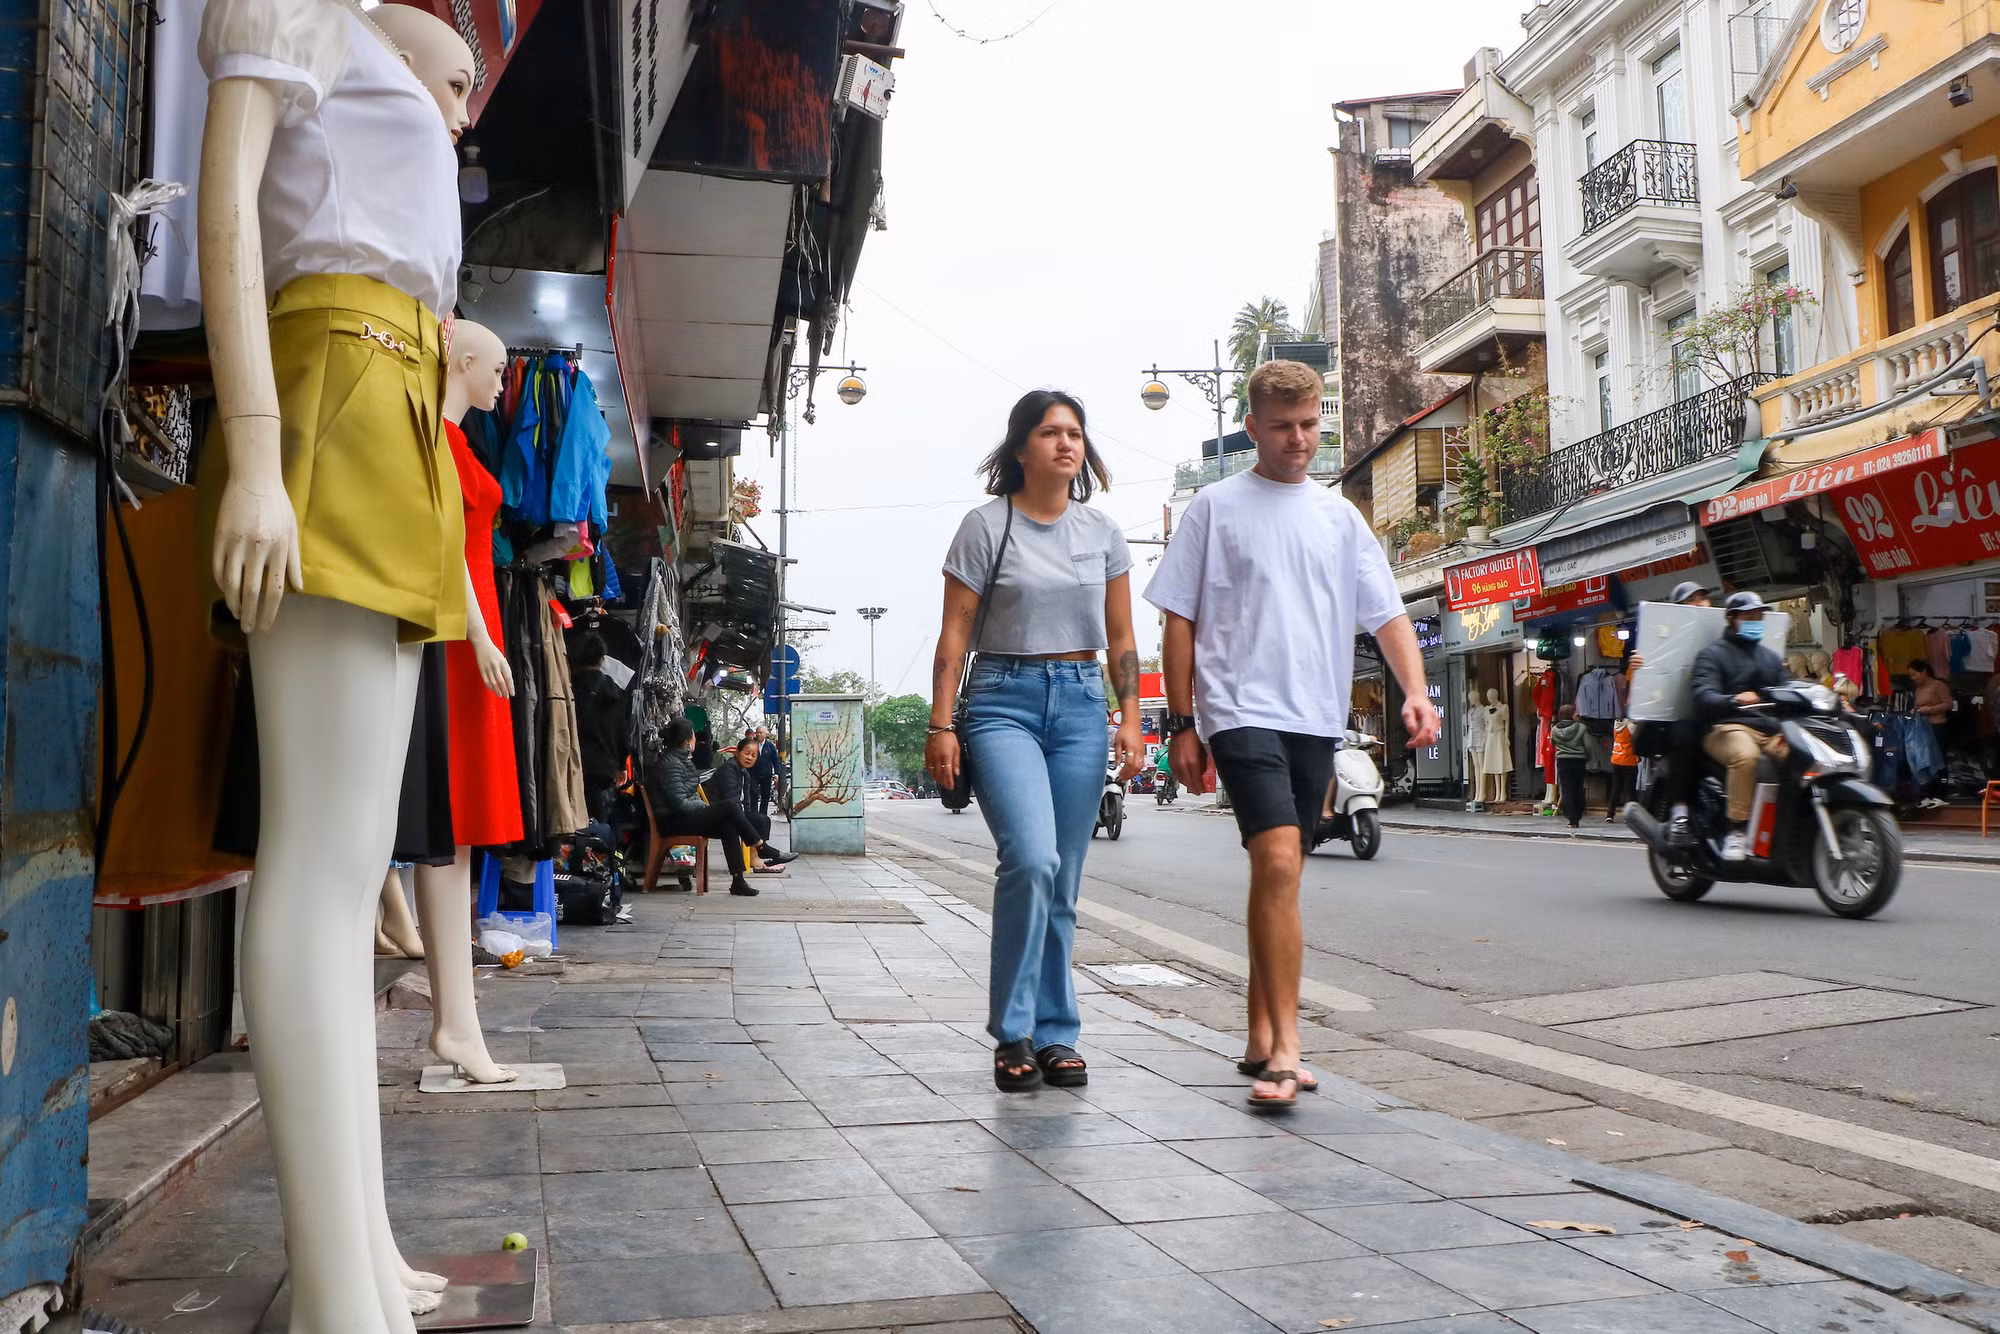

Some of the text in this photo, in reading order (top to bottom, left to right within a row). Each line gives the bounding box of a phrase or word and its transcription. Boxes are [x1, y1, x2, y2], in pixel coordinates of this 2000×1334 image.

[1707, 496, 1738, 522] 92
[1779, 465, 1858, 501] Liên
[1877, 456, 1891, 472] 024
[1892, 444, 1933, 468] 39260118
[1845, 493, 1894, 542] 92
[1461, 557, 1514, 580] FACTORY OUTLET
[1471, 582, 1481, 594] 96
